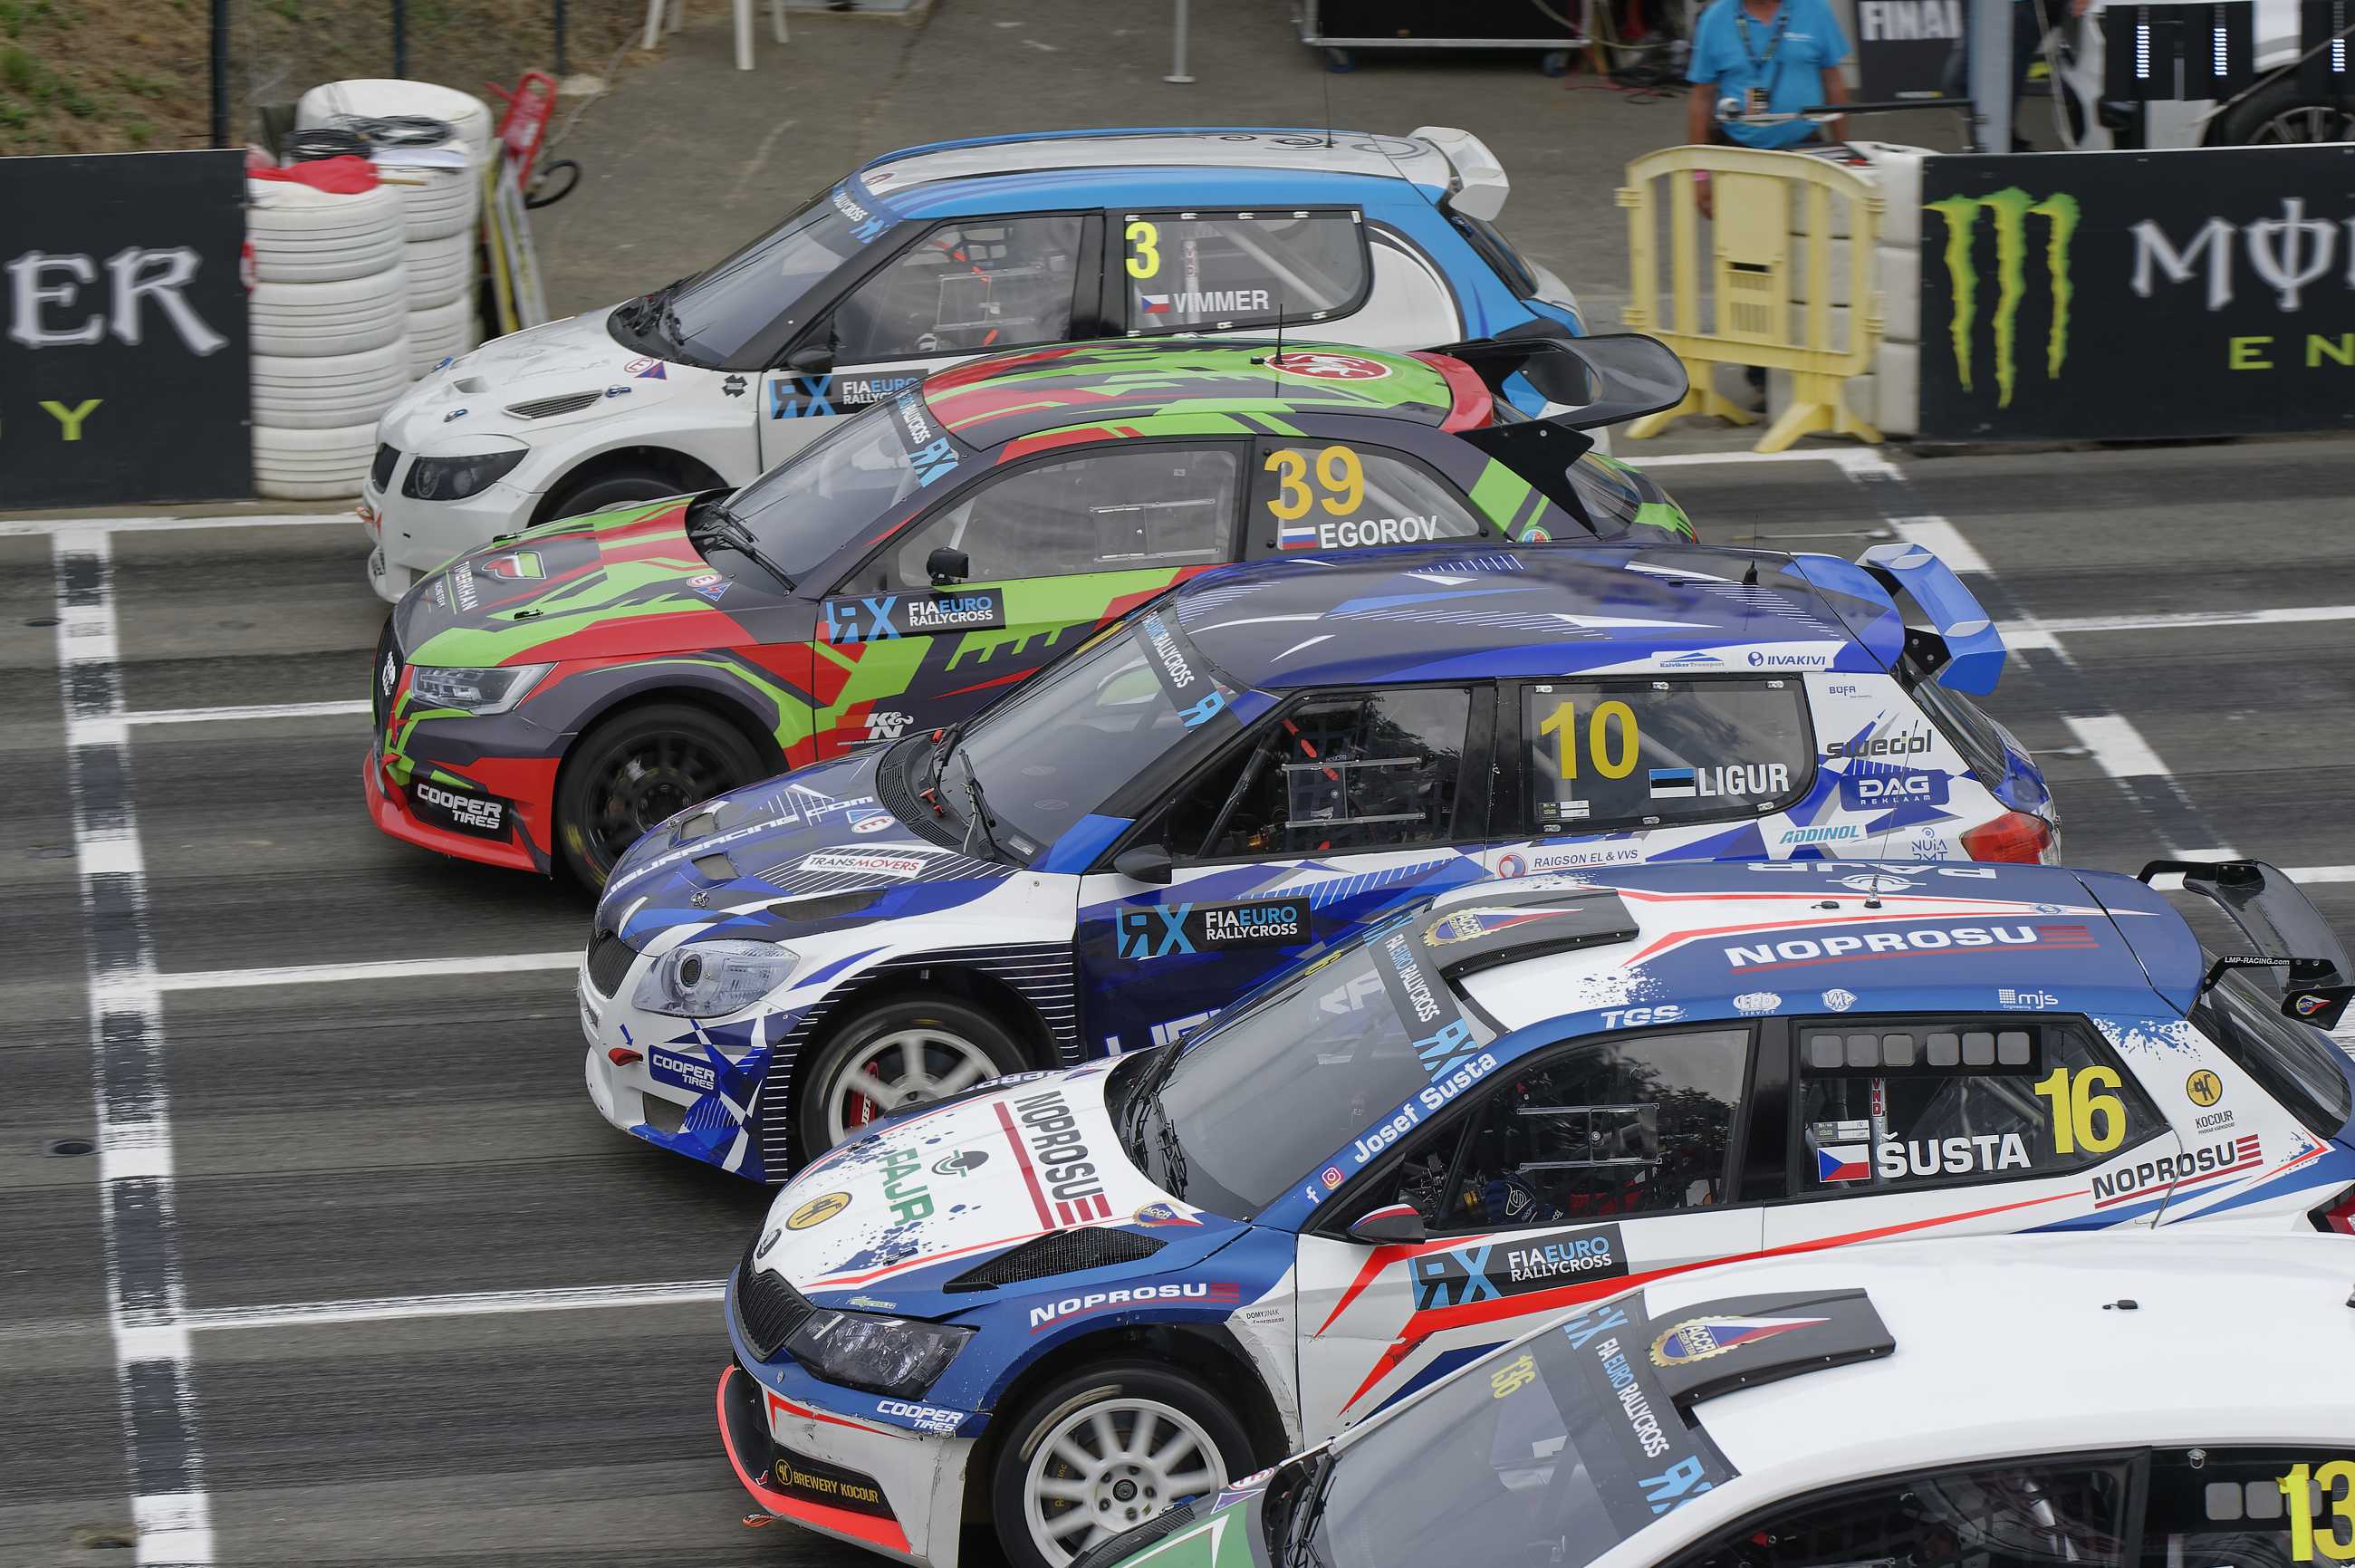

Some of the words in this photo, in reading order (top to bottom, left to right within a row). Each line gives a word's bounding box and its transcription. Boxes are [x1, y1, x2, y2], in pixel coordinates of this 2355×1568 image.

[1125, 221, 1160, 279] 3
[2129, 197, 2355, 311] MO
[1173, 290, 1270, 313] VIMMER
[39, 399, 102, 441] Y
[1264, 445, 1364, 520] 39
[1319, 515, 1437, 549] EGOROV
[909, 610, 994, 628] RALLYCROSS
[1767, 654, 1827, 667] IIVAKIVI
[1540, 699, 1640, 780] 10
[1697, 763, 1791, 797] LIGUR
[1859, 775, 1930, 799] DAG
[417, 783, 502, 818] COOPER
[1860, 794, 1931, 805] REKLAAM
[452, 809, 500, 830] TIRES
[1779, 824, 1860, 844] ADDINOL
[809, 857, 919, 871] TRANSMOVERS
[1534, 854, 1587, 868] RAIGSON
[1591, 852, 1603, 863] EL
[1605, 851, 1616, 861] &
[1615, 849, 1639, 861] VVS
[1206, 922, 1299, 941] RALLYCROSS
[1724, 926, 2038, 967] NOPROSU
[2224, 956, 2291, 966] LMP-RACING.com
[1398, 965, 1441, 1023] RALLYCROSS
[2018, 989, 2059, 1010] mjs
[1600, 1005, 1681, 1030] TGS
[652, 1053, 716, 1082] COOPER
[681, 1073, 716, 1091] TIRES
[1353, 1102, 1420, 1164] Josef
[1419, 1053, 1497, 1111] Susta
[2033, 1064, 2128, 1155] 16
[2195, 1109, 2235, 1130] KOCOUR
[1014, 1090, 1105, 1201] NOPROSU
[1876, 1131, 2032, 1179] ŠUSTA
[2091, 1140, 2236, 1200] NOPROSU
[1510, 1254, 1613, 1283] RALLYCROSS
[1029, 1283, 1208, 1328] NOPROSU
[1684, 1325, 1720, 1353] ACCR
[876, 1400, 965, 1425] COOPER
[912, 1419, 956, 1433] TIRES
[1617, 1381, 1669, 1458] RALLYCROSS
[793, 1470, 838, 1494] BREWERY
[840, 1483, 880, 1504] KOCOUR
[2274, 1459, 2355, 1562] 13
